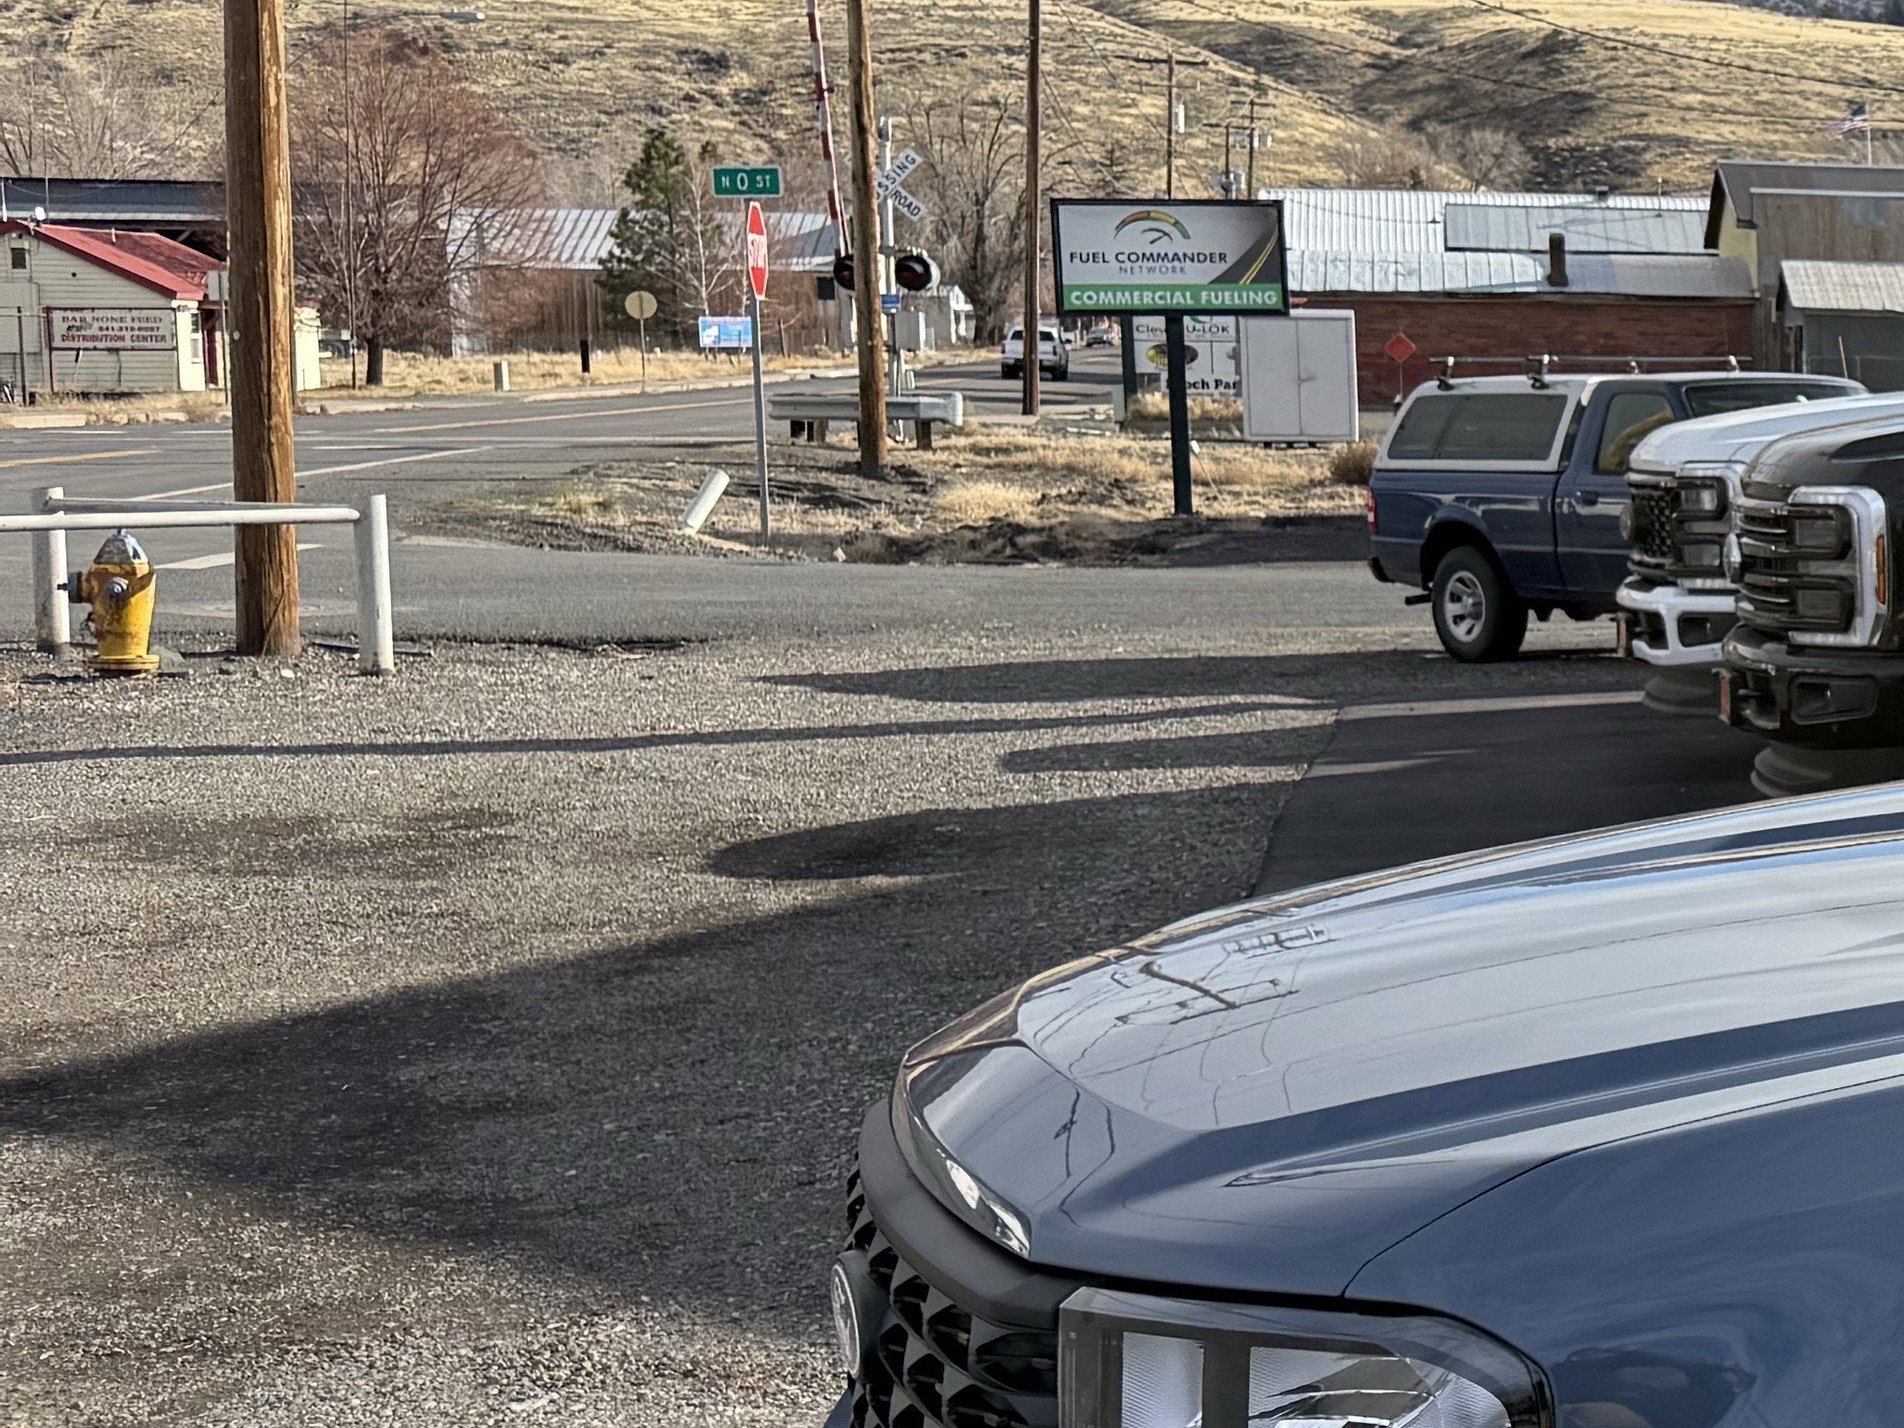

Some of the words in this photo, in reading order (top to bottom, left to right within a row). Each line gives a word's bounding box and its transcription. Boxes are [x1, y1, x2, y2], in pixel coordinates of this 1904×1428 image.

[721, 175, 730, 188] N
[755, 174, 772, 188] ST
[1069, 251, 1110, 264] FUEL
[1114, 251, 1228, 264] COMMANDER
[1118, 265, 1187, 275] NETWORK
[1070, 290, 1195, 306] COMMERCIAL
[1200, 290, 1278, 306] FUELING
[92, 315, 128, 324] NONE
[61, 333, 126, 343] DISTRIBUTION
[130, 334, 168, 343] CENTER
